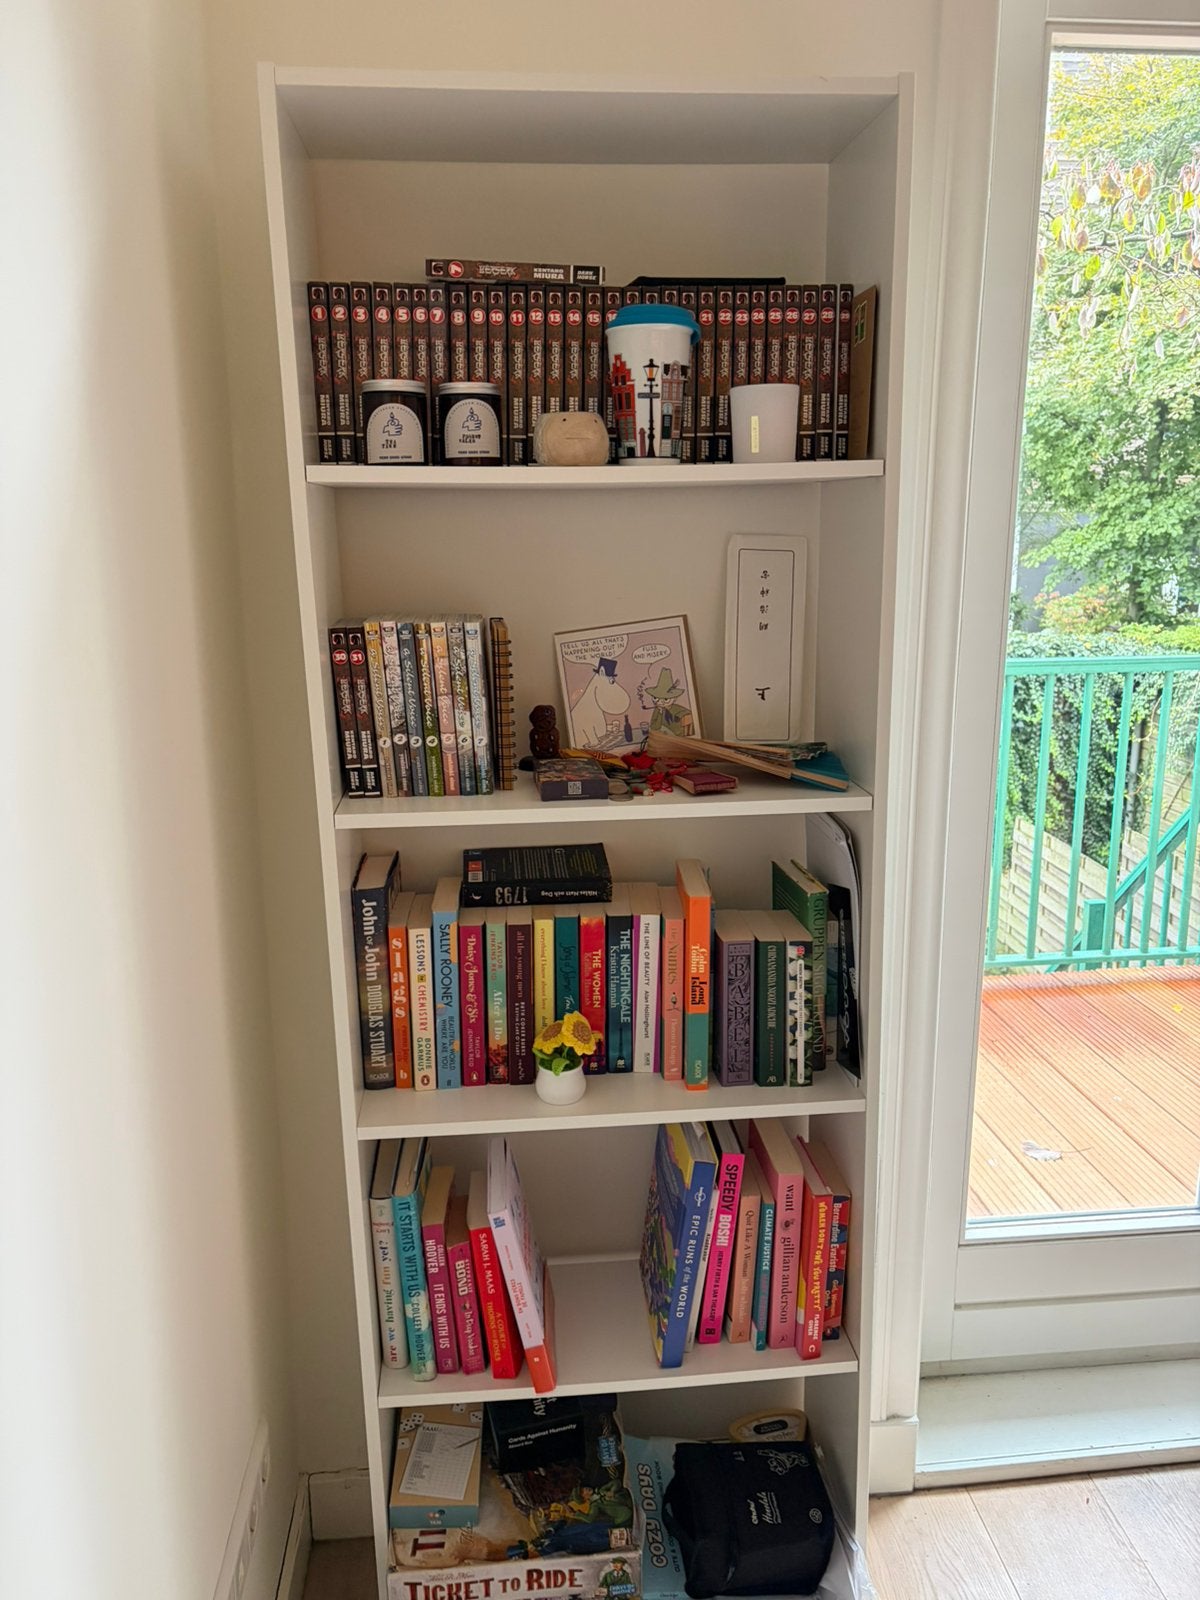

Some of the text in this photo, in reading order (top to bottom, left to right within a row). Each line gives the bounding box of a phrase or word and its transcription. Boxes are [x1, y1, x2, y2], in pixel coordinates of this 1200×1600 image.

[564, 647, 600, 656] HAPPENING
[404, 659, 417, 729] Silent Voice
[421, 659, 433, 728] Silent Voice
[439, 695, 450, 725] Voice
[361, 730, 369, 760] MIURA
[495, 886, 528, 905] 1793
[361, 899, 378, 936] John
[812, 898, 825, 962] GRUPPEN
[489, 930, 498, 981] JENKINS REID
[538, 927, 547, 958] everything
[644, 952, 650, 960] OF
[698, 948, 707, 973] Colm
[364, 945, 379, 982] John
[439, 923, 454, 1008] SALLY ROONEY
[464, 934, 478, 993] Daisy Jones
[514, 930, 525, 998] all the young men
[583, 952, 592, 1005] Kristin Hannah
[592, 949, 601, 1008] THE WOMEN
[610, 945, 619, 1008] Kristin Hannah
[620, 929, 630, 1023] THE NIGHTINGALE
[668, 943, 680, 985] Names
[766, 945, 777, 987] CHIMAMANDA
[415, 933, 428, 1032] LESSONS CHEMISTRY
[540, 980, 548, 997] about
[690, 976, 699, 1005] Island
[697, 980, 707, 1005] Long
[366, 984, 383, 1028] DOUGLAS
[492, 989, 503, 1041] After Do
[540, 998, 548, 1010] love
[642, 1004, 651, 1039] Hollinghurst
[440, 1018, 449, 1070] WHERE ARE YOU
[447, 1015, 456, 1047] BEAUTIFUL
[467, 1027, 475, 1053] JENKINS
[369, 1031, 387, 1068] STUART
[416, 1036, 425, 1072] GARMUS
[424, 1037, 432, 1070] BONNIE
[716, 1163, 738, 1246] SPEEDY BOSH!
[784, 1184, 795, 1212] want
[690, 1215, 701, 1236] EPIC
[741, 1209, 755, 1278] Quit Like Woman
[761, 1208, 773, 1271] CLIMATE JUSTICE
[829, 1202, 842, 1272] Bernardine Evaristo
[378, 1240, 389, 1262] yet?
[398, 1201, 421, 1299] IT STARTS WITH US
[424, 1239, 438, 1274] HOOVER
[437, 1244, 445, 1267] COLLEEN
[478, 1233, 496, 1295] SARAH MAAS
[684, 1239, 697, 1265] RUNS
[811, 1201, 826, 1311] WOMEN OWE PRETTY
[381, 1266, 391, 1286] fun
[455, 1260, 468, 1296] BOND
[779, 1236, 795, 1324] gillian anderson
[383, 1289, 395, 1323] having
[433, 1283, 450, 1349] IT ENDS WITH US
[676, 1285, 689, 1319] WORLD
[387, 1327, 396, 1342] we
[410, 1302, 426, 1362] COLLEEN HOOVER
[486, 1301, 501, 1362] THORNS ROSES
[495, 1319, 506, 1342] COURT
[807, 1319, 815, 1337] GIVEN
[812, 1313, 820, 1340] FLORENCE
[389, 1345, 398, 1362] are
[508, 1423, 577, 1444] Cards Against Humanity
[637, 1463, 669, 1569] COZY DAYS
[404, 1577, 495, 1600] TICKET
[498, 1577, 518, 1592] TO
[525, 1568, 584, 1591] RIDE
